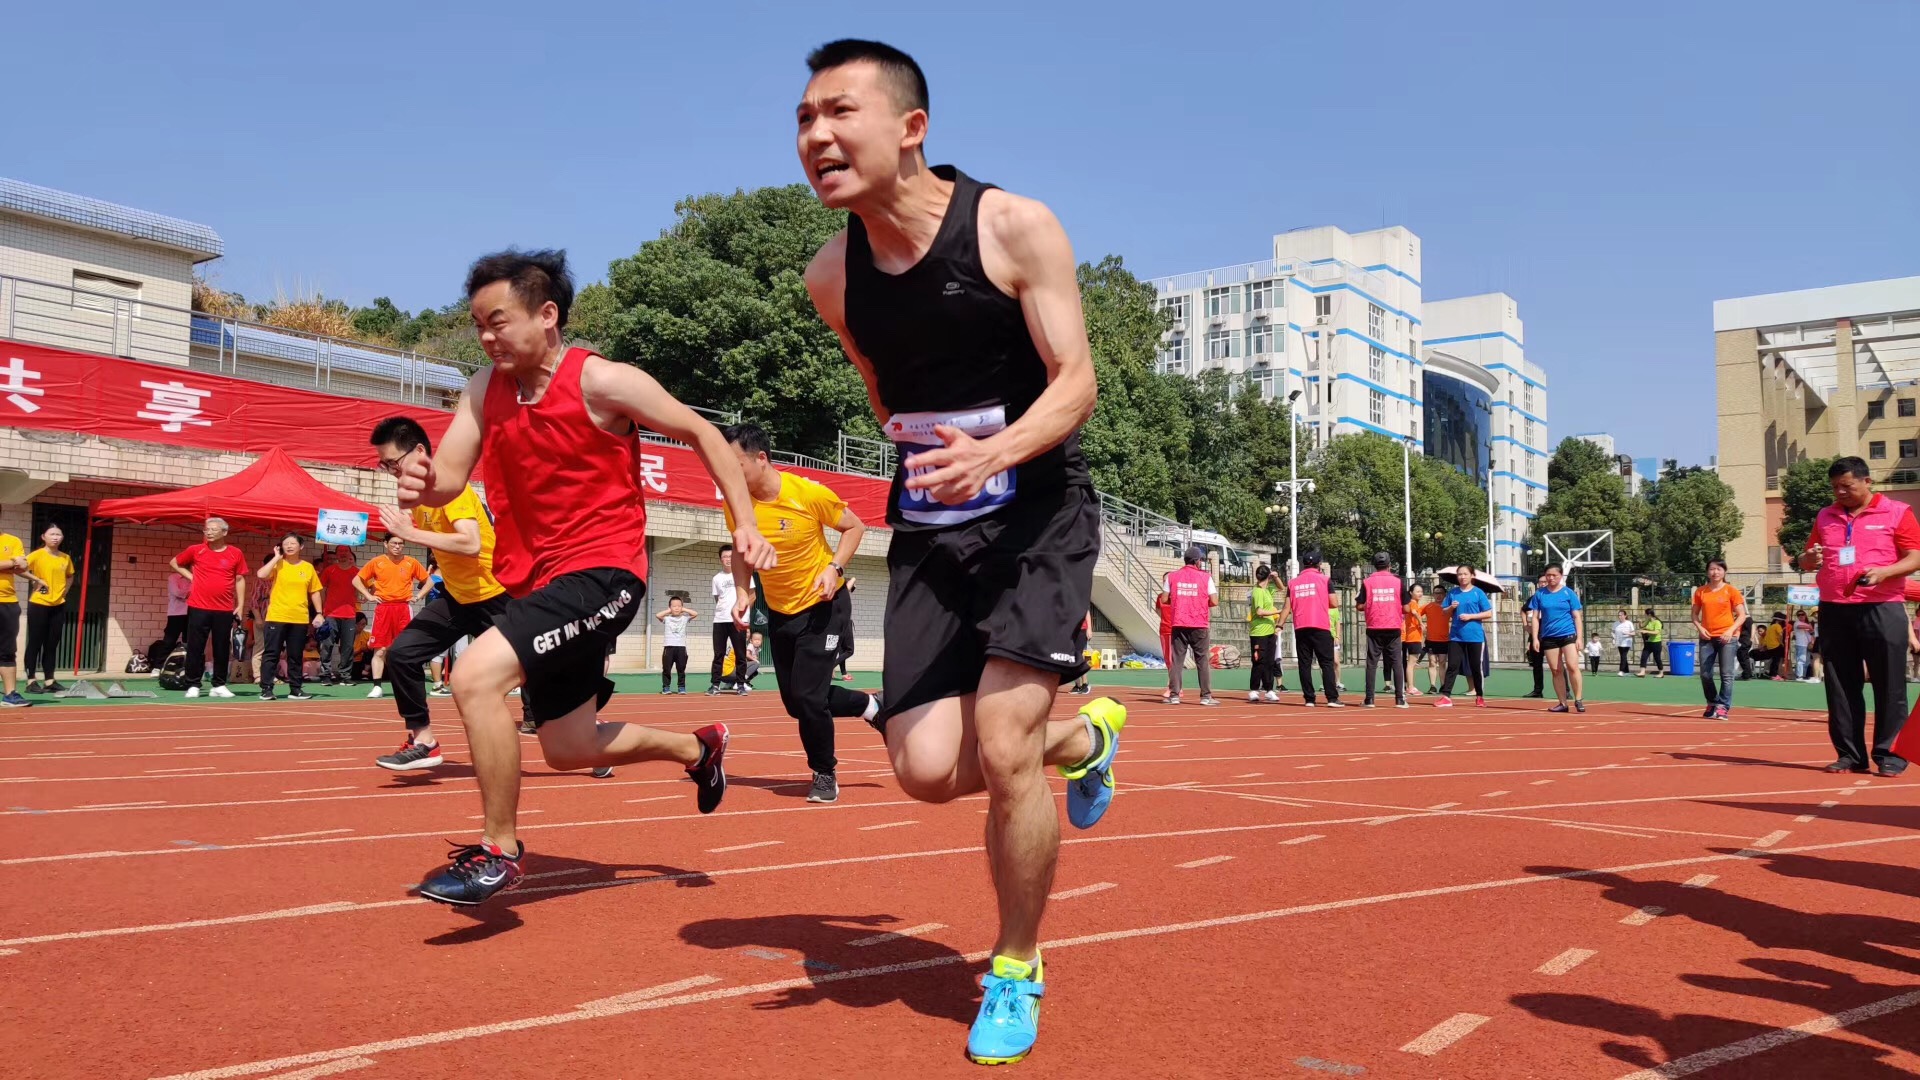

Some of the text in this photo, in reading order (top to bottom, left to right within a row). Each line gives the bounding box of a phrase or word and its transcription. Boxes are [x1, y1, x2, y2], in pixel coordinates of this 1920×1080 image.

[326, 523, 361, 536] 检录处
[533, 628, 562, 655] GET
[563, 620, 580, 640] IN
[599, 589, 632, 619] RING
